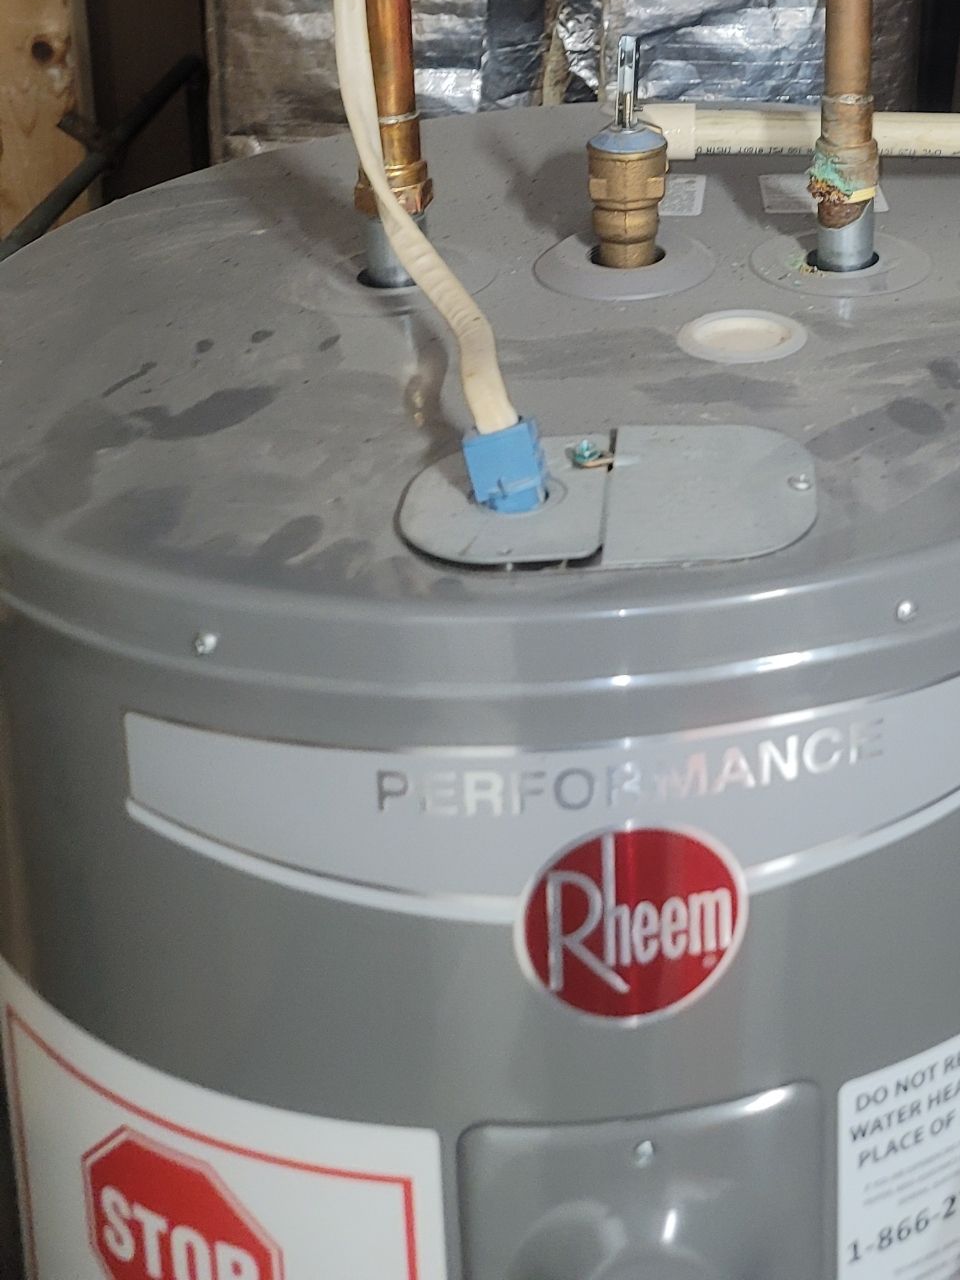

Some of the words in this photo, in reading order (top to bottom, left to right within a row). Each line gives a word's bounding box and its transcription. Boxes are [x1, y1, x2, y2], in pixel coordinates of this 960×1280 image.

[375, 718, 884, 817] PERFORMANCE
[546, 831, 733, 995] Rheem
[849, 1100, 922, 1142] WATER
[855, 1086, 888, 1112] DO
[894, 1061, 940, 1097] NOT
[857, 1125, 924, 1168] PLACE
[930, 1112, 956, 1136] OF
[101, 1185, 259, 1280] STOP
